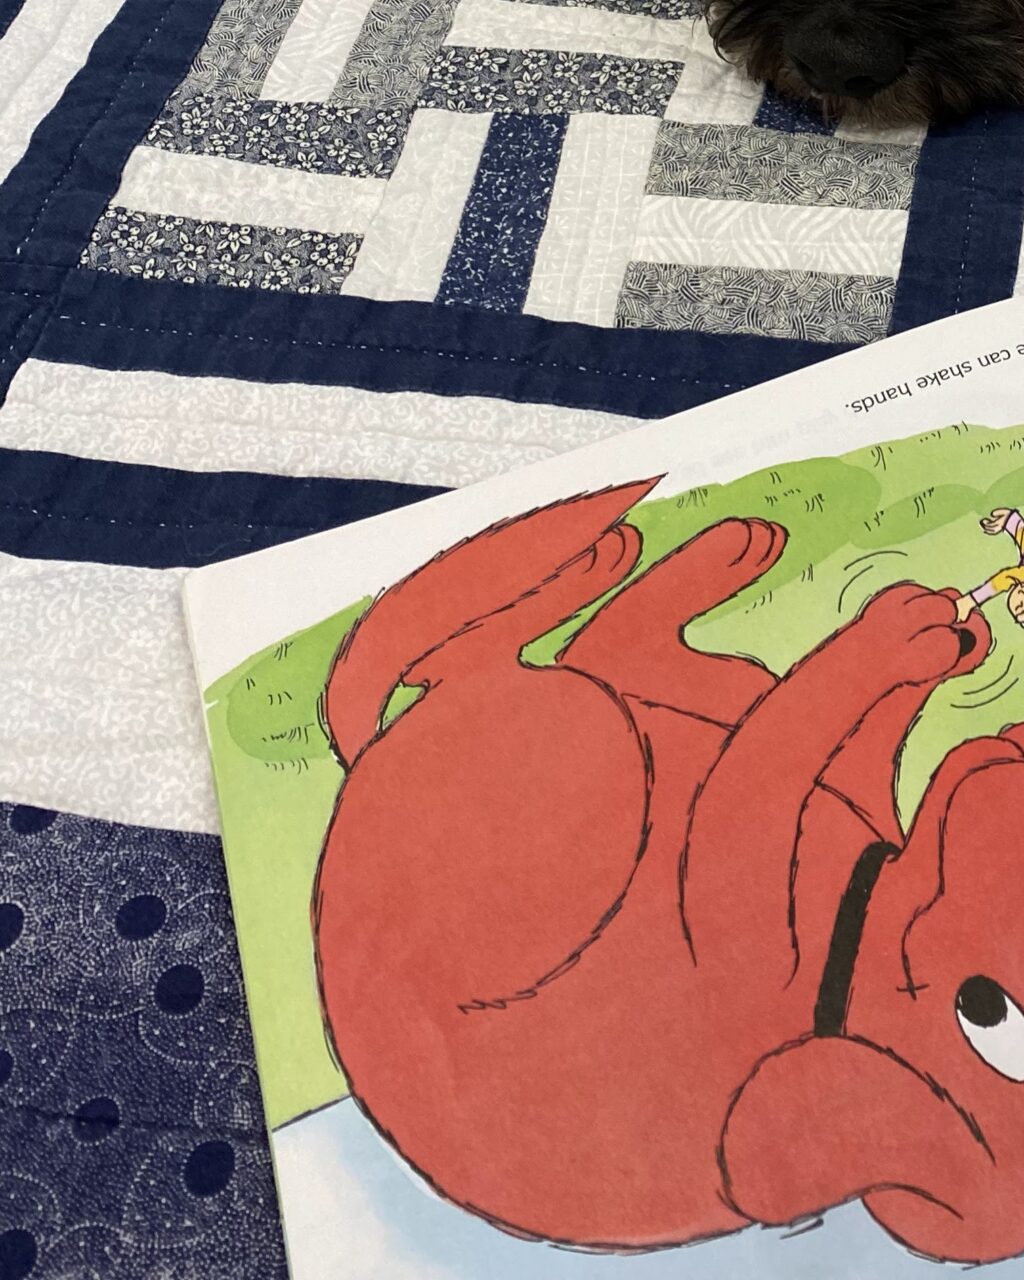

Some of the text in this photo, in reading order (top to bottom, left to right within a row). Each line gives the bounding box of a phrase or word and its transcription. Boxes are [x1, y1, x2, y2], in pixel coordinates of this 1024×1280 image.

[978, 349, 1011, 368] can
[917, 361, 972, 390] shake
[846, 382, 911, 413] hands.
